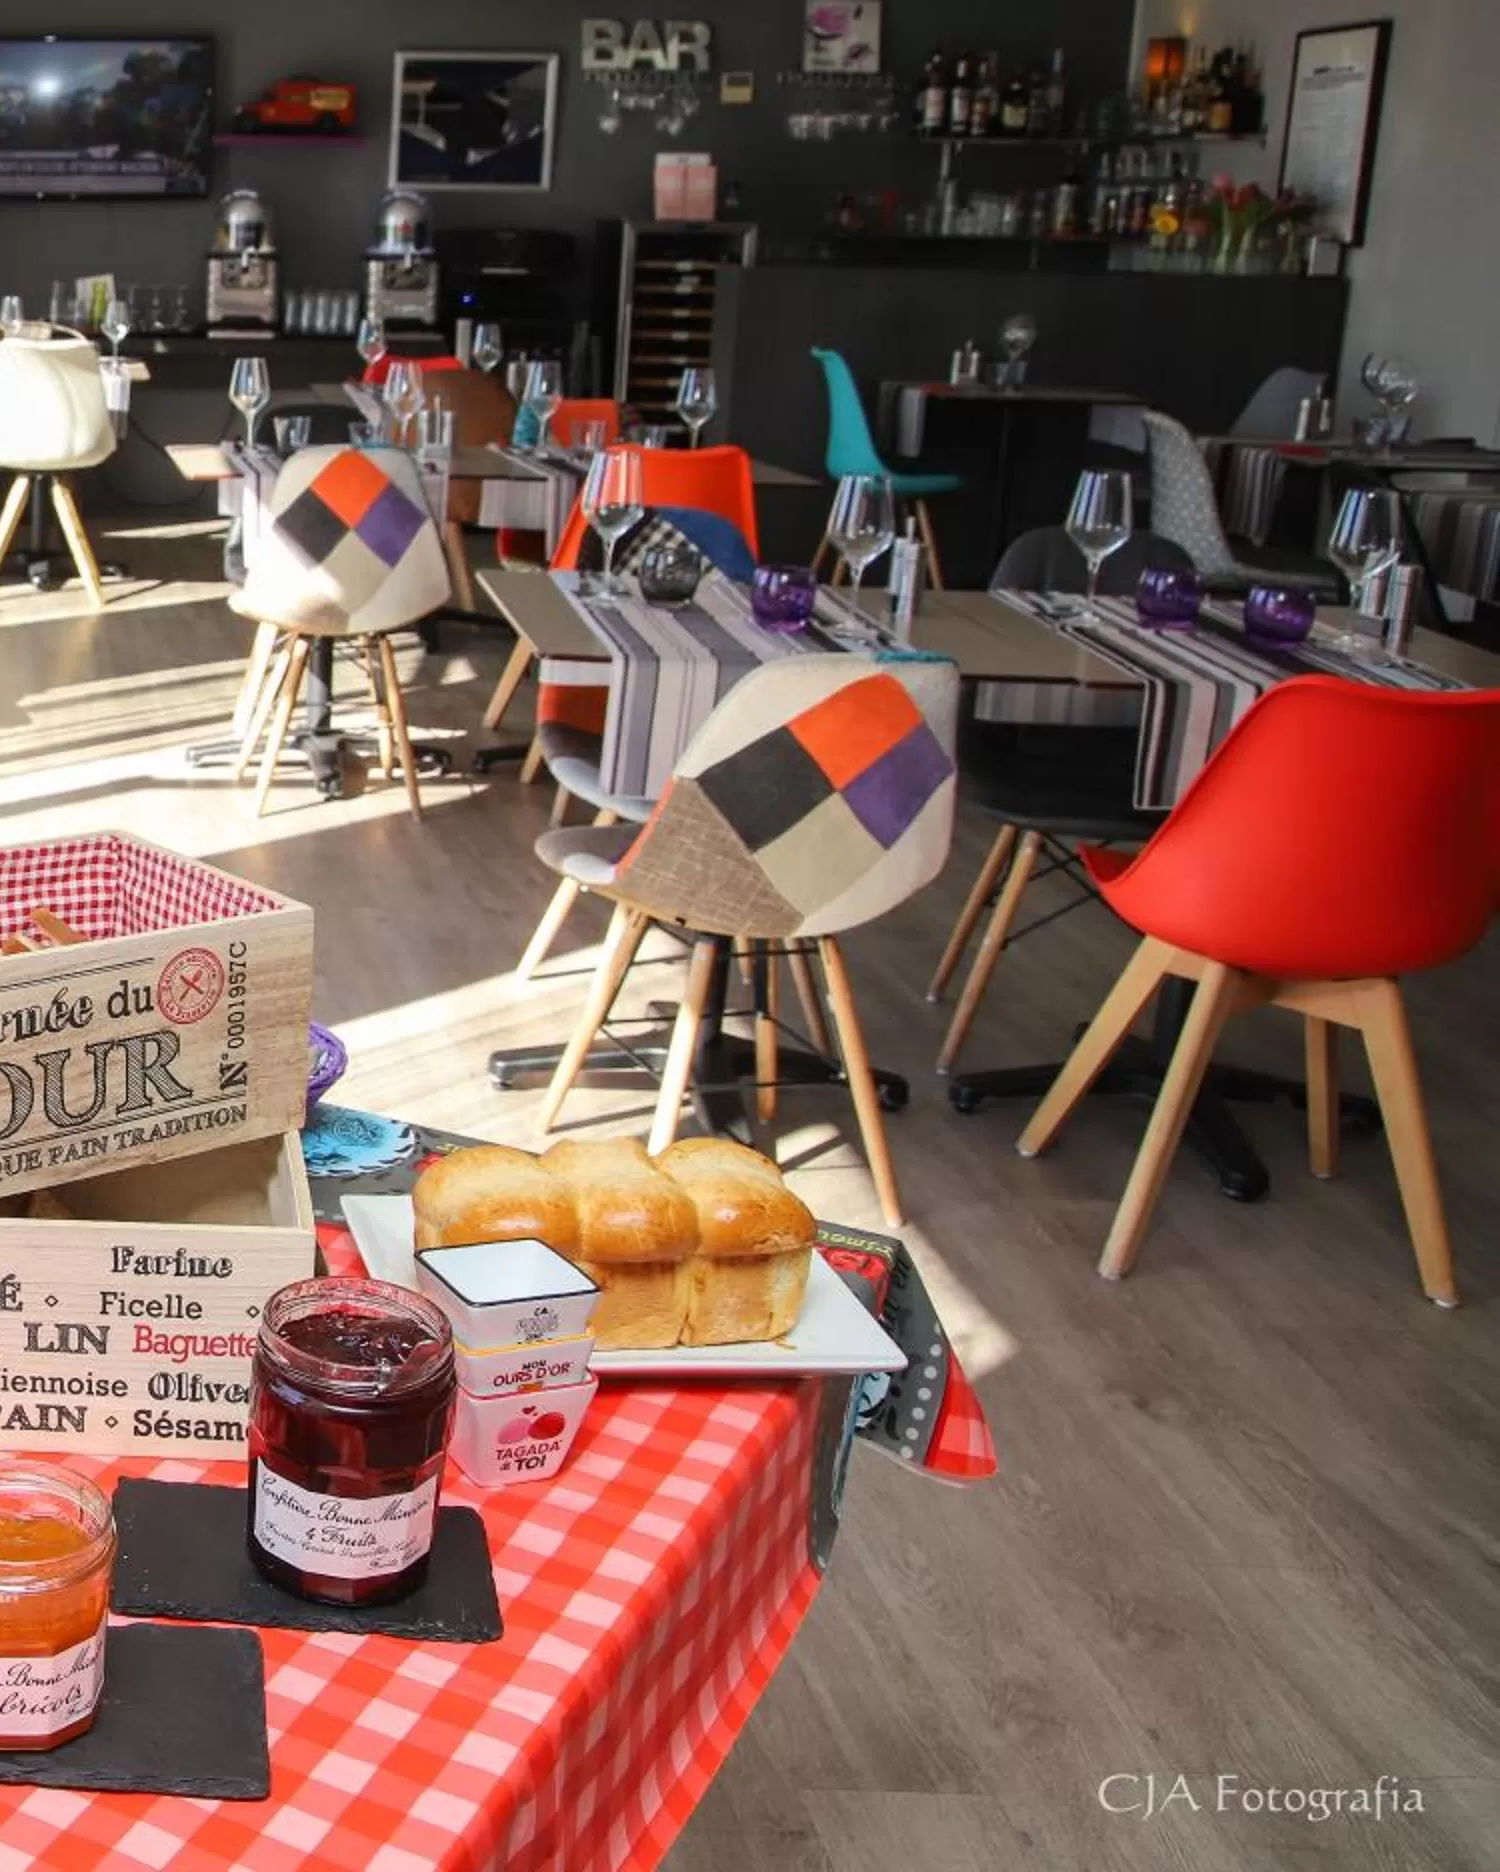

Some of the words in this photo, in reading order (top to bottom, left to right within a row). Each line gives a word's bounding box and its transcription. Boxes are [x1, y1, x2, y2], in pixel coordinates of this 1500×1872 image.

[581, 18, 711, 70] BAR
[107, 980, 155, 1019] du
[227, 940, 247, 1049] 0001957C
[49, 1138, 108, 1167] PAIN
[114, 1104, 247, 1151] TRADITION
[111, 1246, 233, 1278] Farine
[99, 1291, 203, 1319] Ficelle
[23, 1322, 110, 1355] LIN
[148, 1371, 250, 1403] Olive
[493, 1370, 533, 1387] OURS
[536, 1362, 571, 1379] D'OR
[133, 1409, 251, 1441] Sésam
[496, 1441, 560, 1461] TAGADA
[514, 1455, 547, 1472] TOI
[260, 1473, 316, 1520] Confiture
[317, 1500, 373, 1525] Bonne
[321, 1526, 378, 1547] Fruits
[5, 1661, 64, 1687] Bonne
